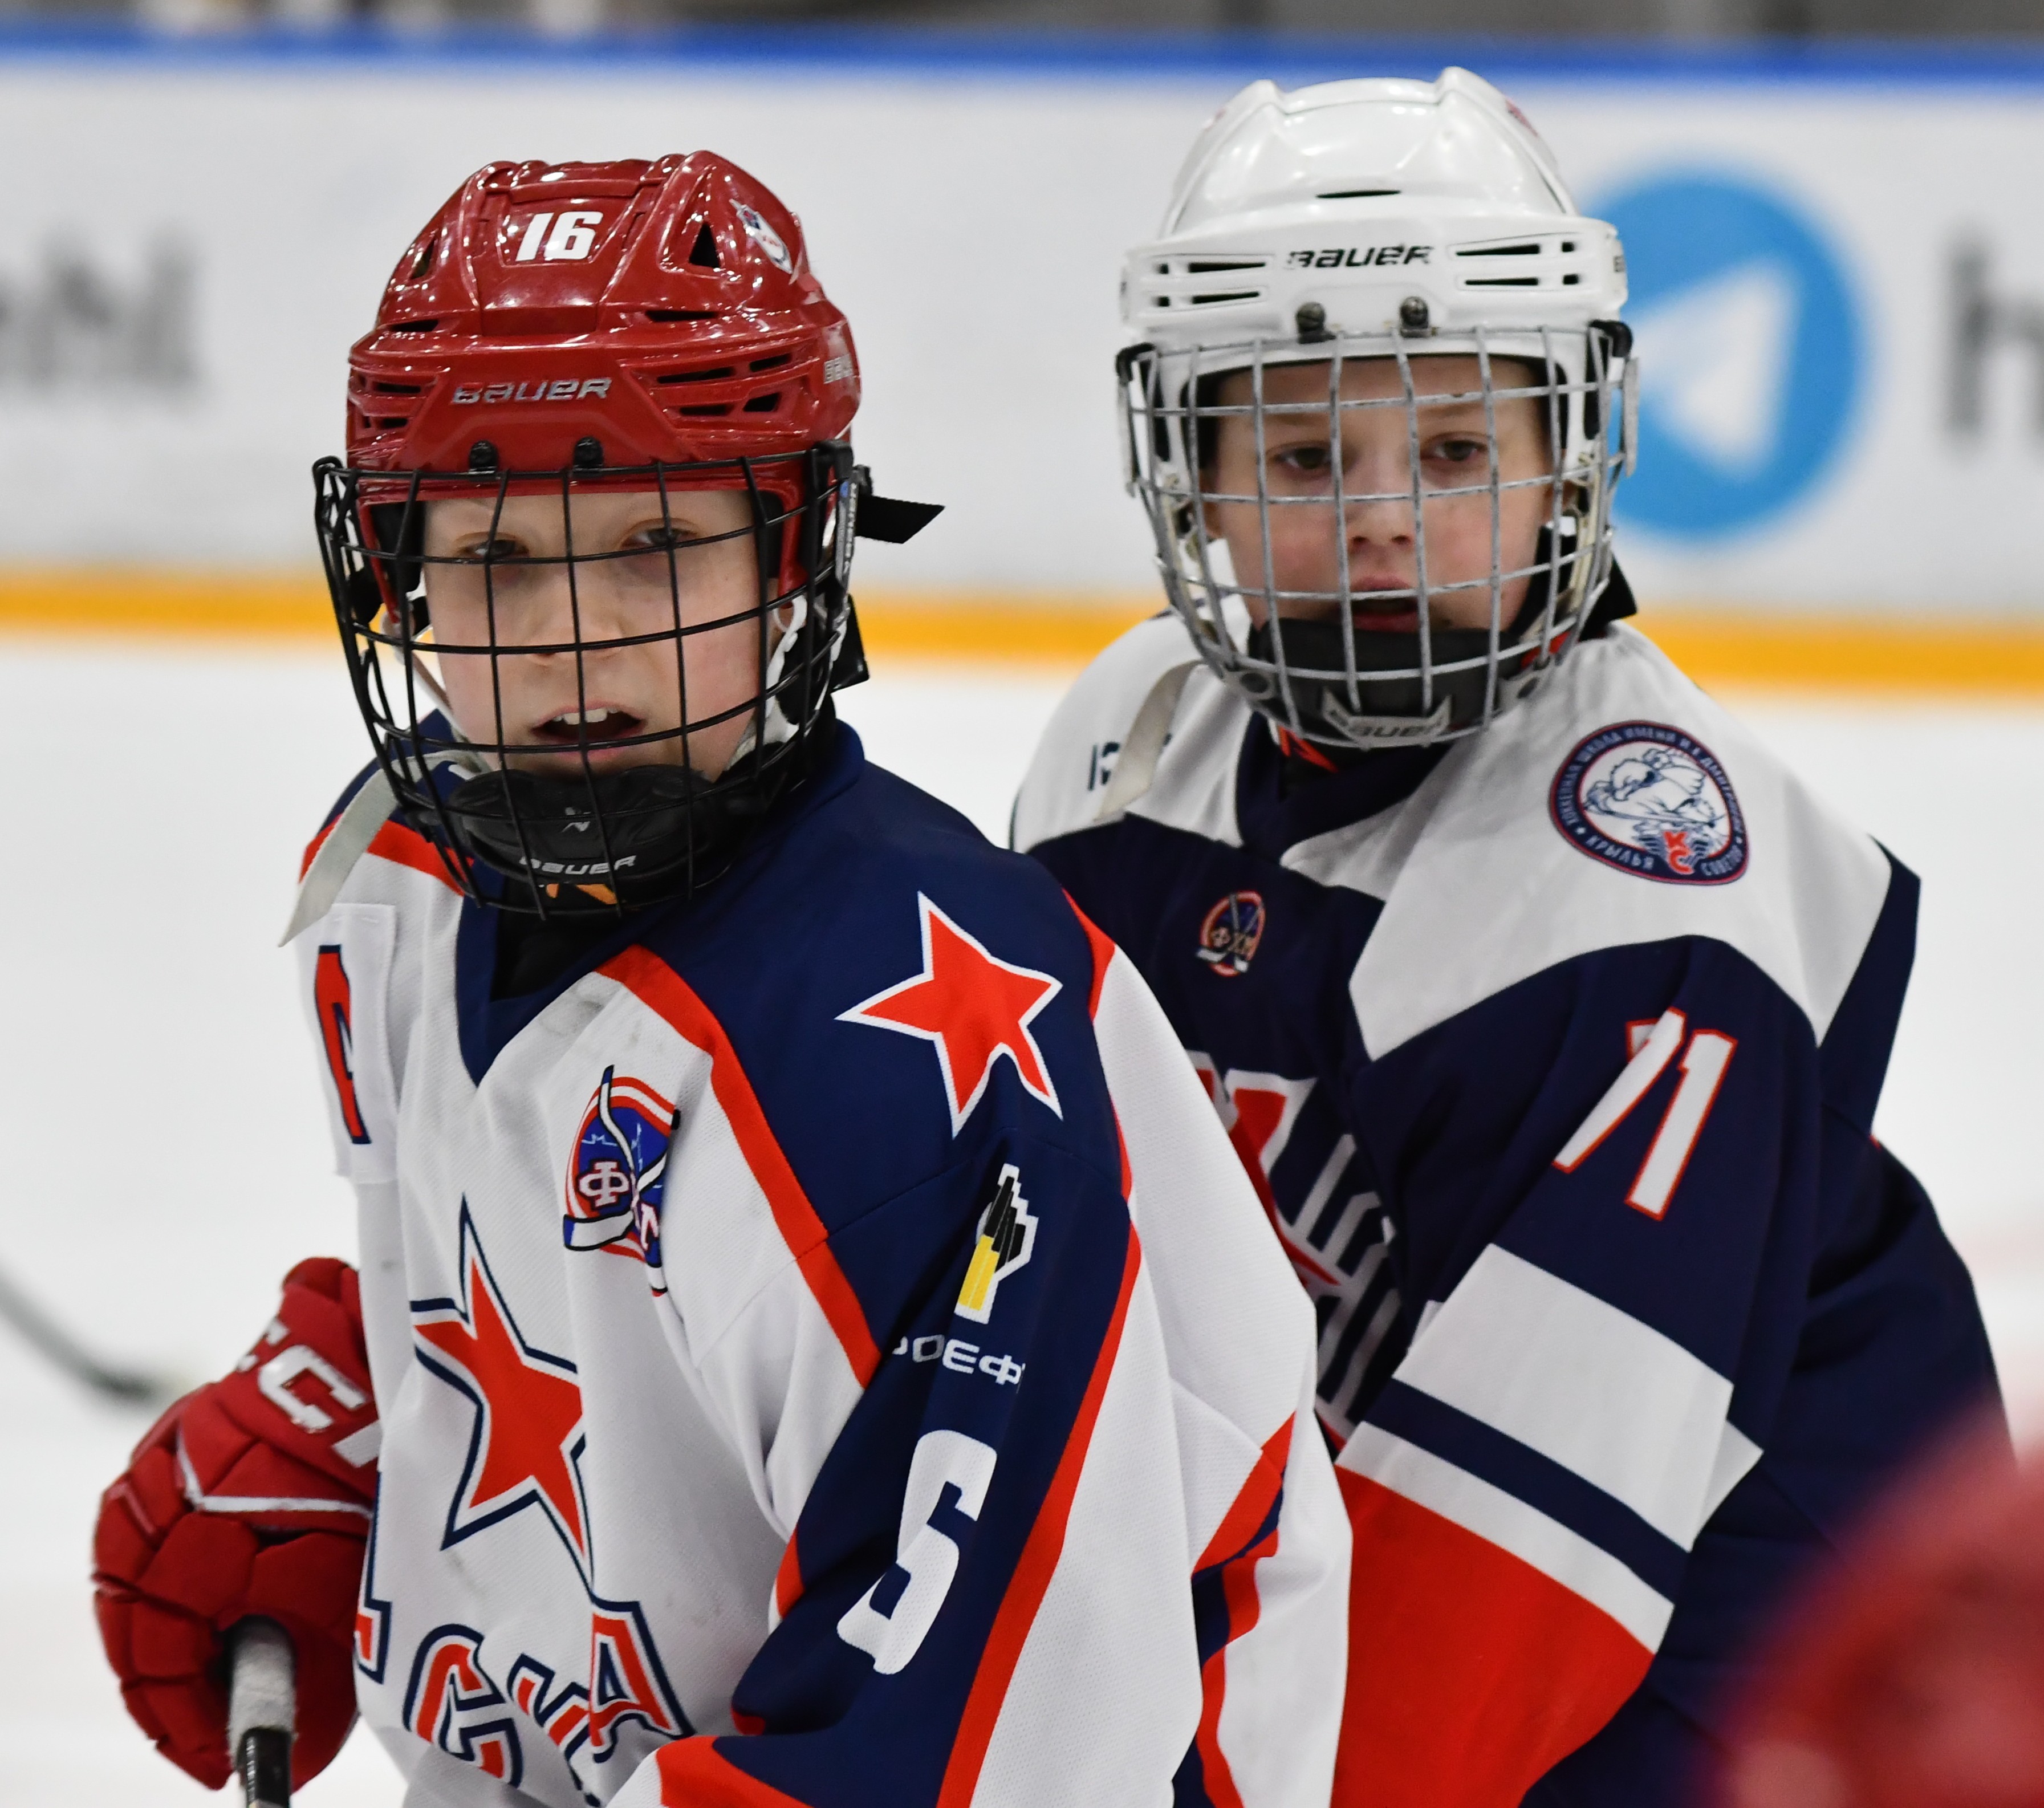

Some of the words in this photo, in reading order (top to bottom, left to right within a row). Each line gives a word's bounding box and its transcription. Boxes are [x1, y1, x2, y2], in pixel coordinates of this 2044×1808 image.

[515, 212, 604, 261] 16
[1283, 243, 1433, 270] BAUER
[451, 377, 612, 404] BAUER
[519, 855, 636, 875] BAUER
